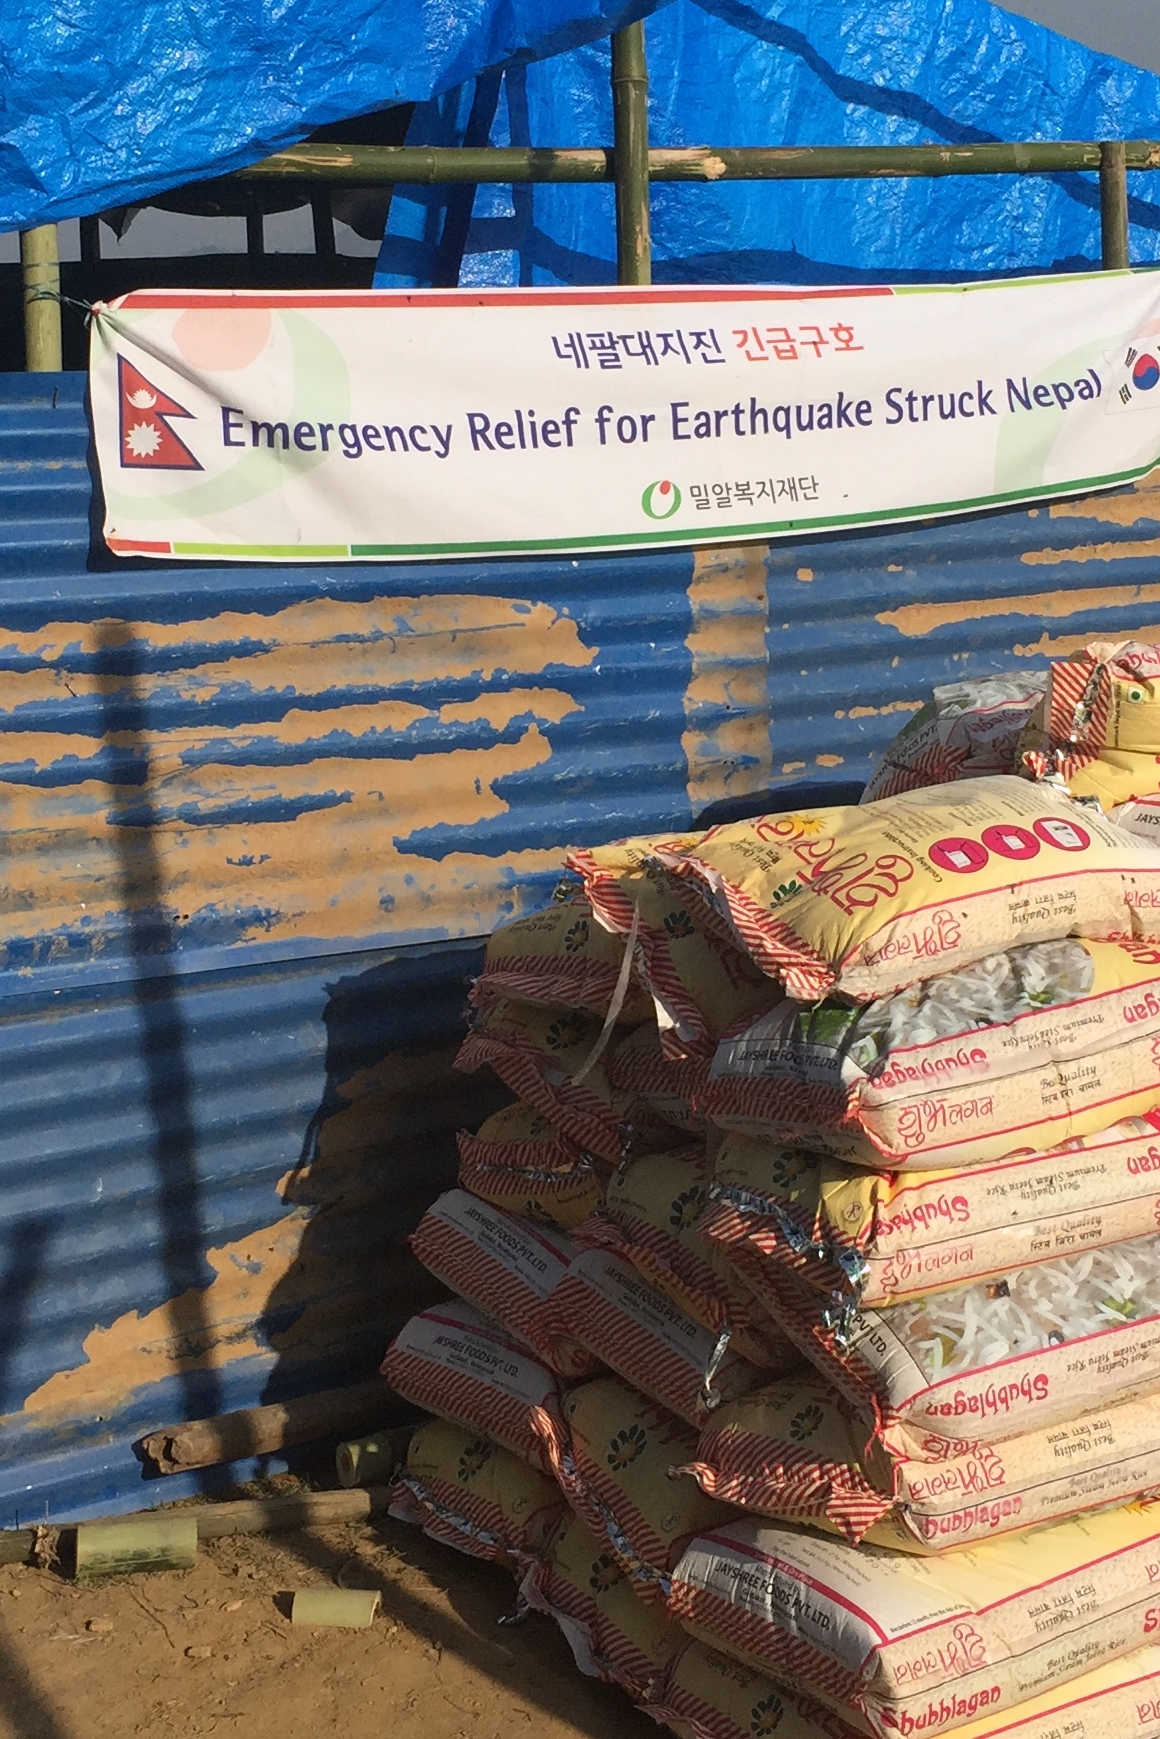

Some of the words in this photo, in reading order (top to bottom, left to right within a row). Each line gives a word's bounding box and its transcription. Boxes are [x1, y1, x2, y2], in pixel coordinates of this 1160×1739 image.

[550, 328, 726, 371] 네팔대지진
[731, 322, 865, 362] 긴급구호
[219, 405, 453, 459] Emergency
[466, 406, 581, 450] Relief
[595, 405, 656, 445] for
[669, 391, 874, 441] Earthquake
[885, 379, 999, 425] Struck
[1004, 368, 1103, 412] Nepal
[688, 474, 821, 511] 밀알복지재단
[1012, 907, 1050, 924] Quality
[1054, 904, 1077, 915] Best
[865, 909, 961, 966] शुभलगन
[870, 1047, 987, 1090] Shubhlagan
[899, 1095, 995, 1148] शुभलगन
[1067, 1163, 1108, 1179] Premium
[986, 1183, 1008, 1196] Rice
[1020, 1184, 1057, 1201] Quality
[1058, 1180, 1082, 1192] Best
[1061, 1215, 1102, 1234] Quality
[870, 1332, 888, 1357] LTD.
[1066, 1360, 1087, 1373] Rice
[1096, 1356, 1130, 1374] Quality
[925, 1373, 1050, 1420] Shubhlagan
[1053, 1438, 1092, 1458] Quality
[1093, 1434, 1116, 1447] Best
[908, 1450, 1006, 1500] शुभलगन
[714, 1560, 761, 1591] JAYSHREE
[811, 1610, 831, 1631] LTD.
[893, 1622, 988, 1687] शुभलगन
[1046, 1656, 1066, 1672] Best
[1067, 1641, 1100, 1662] Quality
